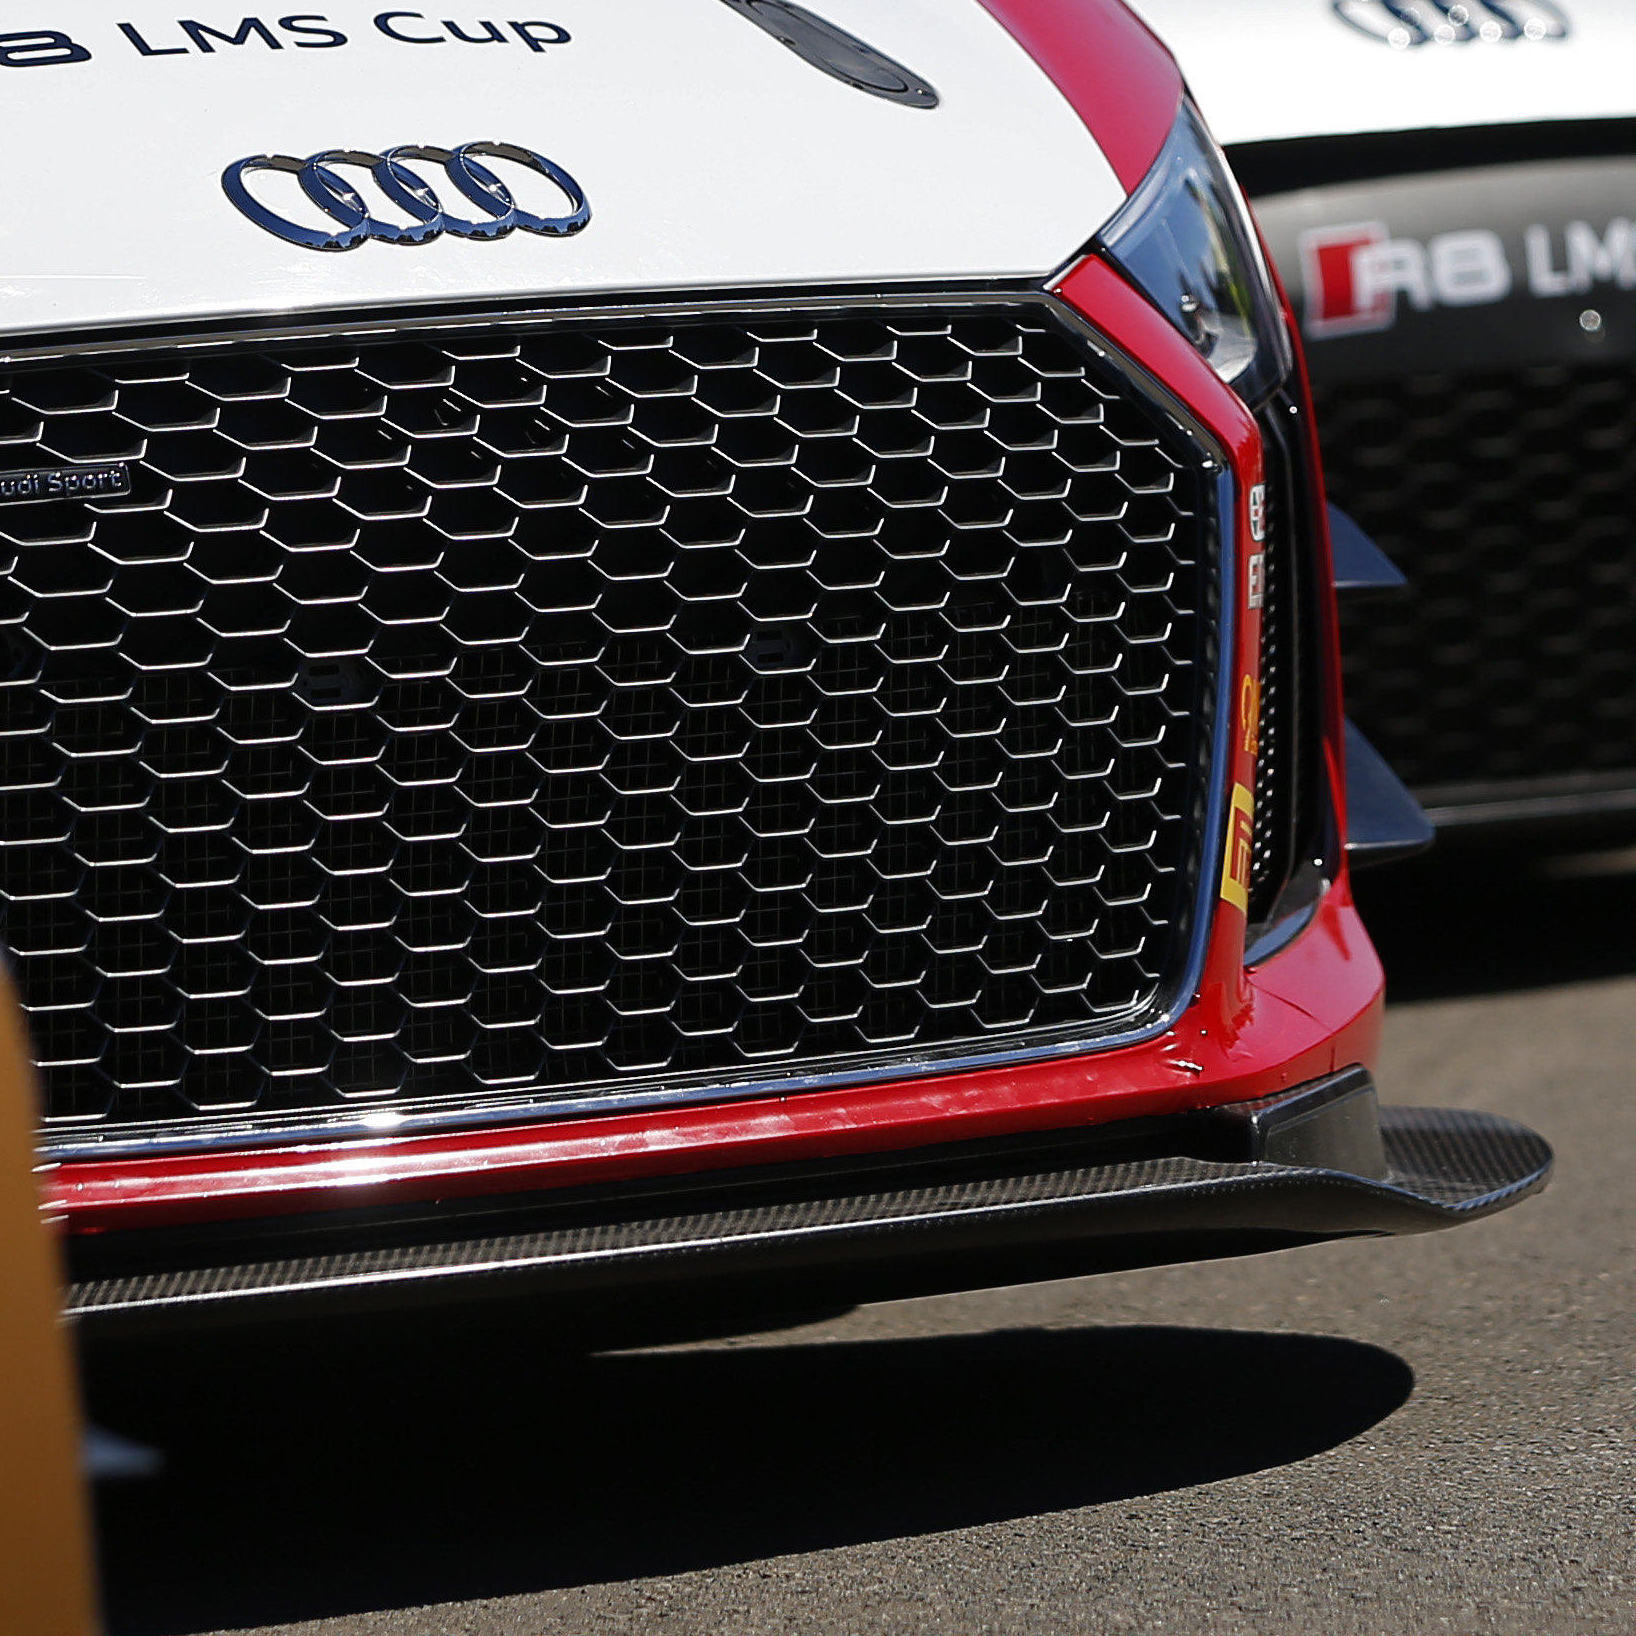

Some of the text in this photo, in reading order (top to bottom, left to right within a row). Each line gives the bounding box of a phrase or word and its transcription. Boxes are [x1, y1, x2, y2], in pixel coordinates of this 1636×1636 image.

[116, 14, 348, 57] LMS
[372, 10, 574, 54] Cup
[1348, 227, 1514, 312] R8
[47, 469, 122, 498] Sport
